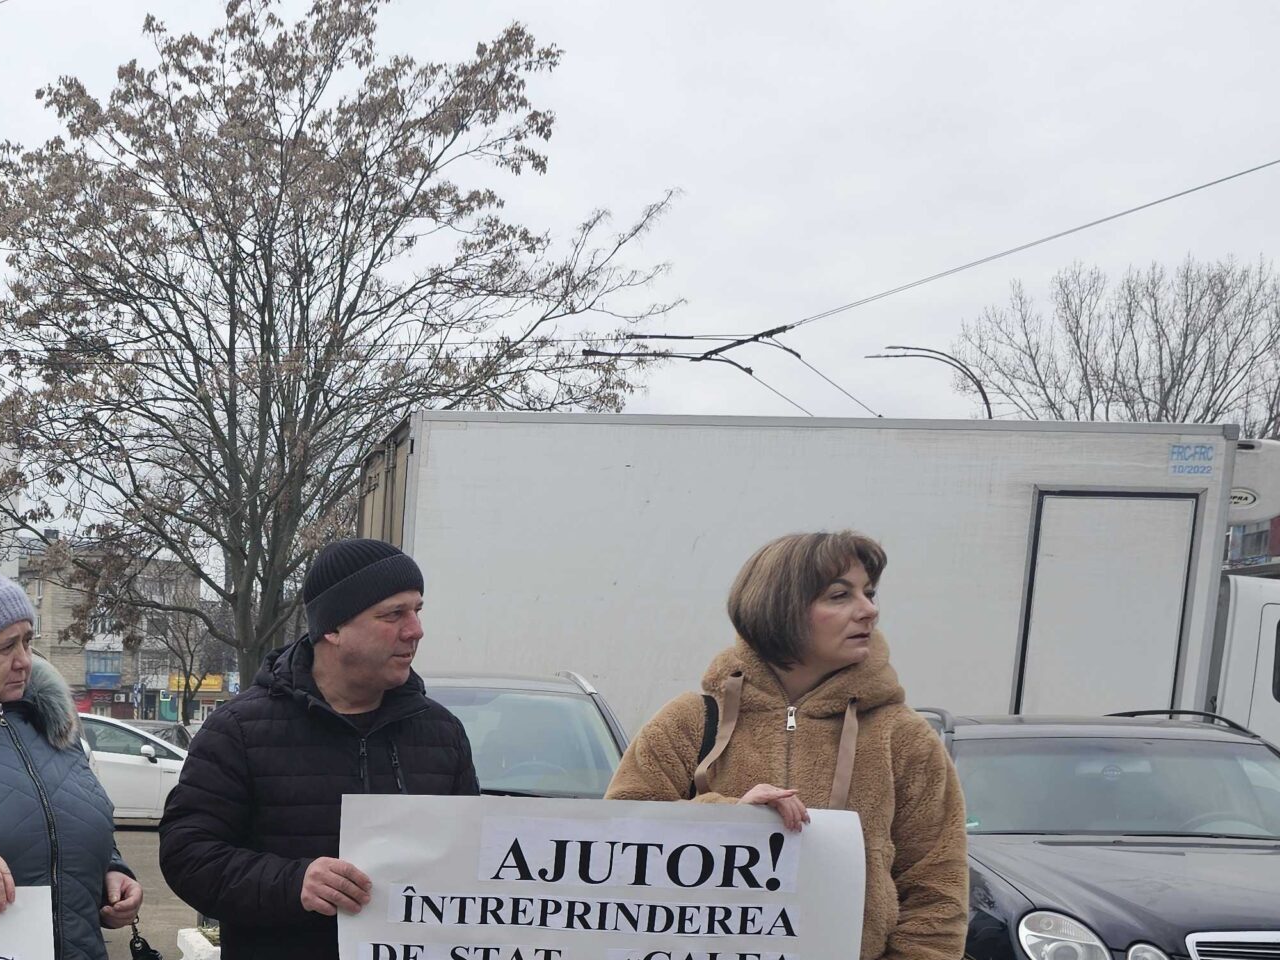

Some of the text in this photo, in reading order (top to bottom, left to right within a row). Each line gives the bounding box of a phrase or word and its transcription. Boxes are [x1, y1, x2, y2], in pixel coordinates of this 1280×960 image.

[1171, 465, 1212, 474] 10/2022
[491, 832, 785, 891] AJUTOR!
[403, 886, 796, 936] ÎNTREPRINDEREA
